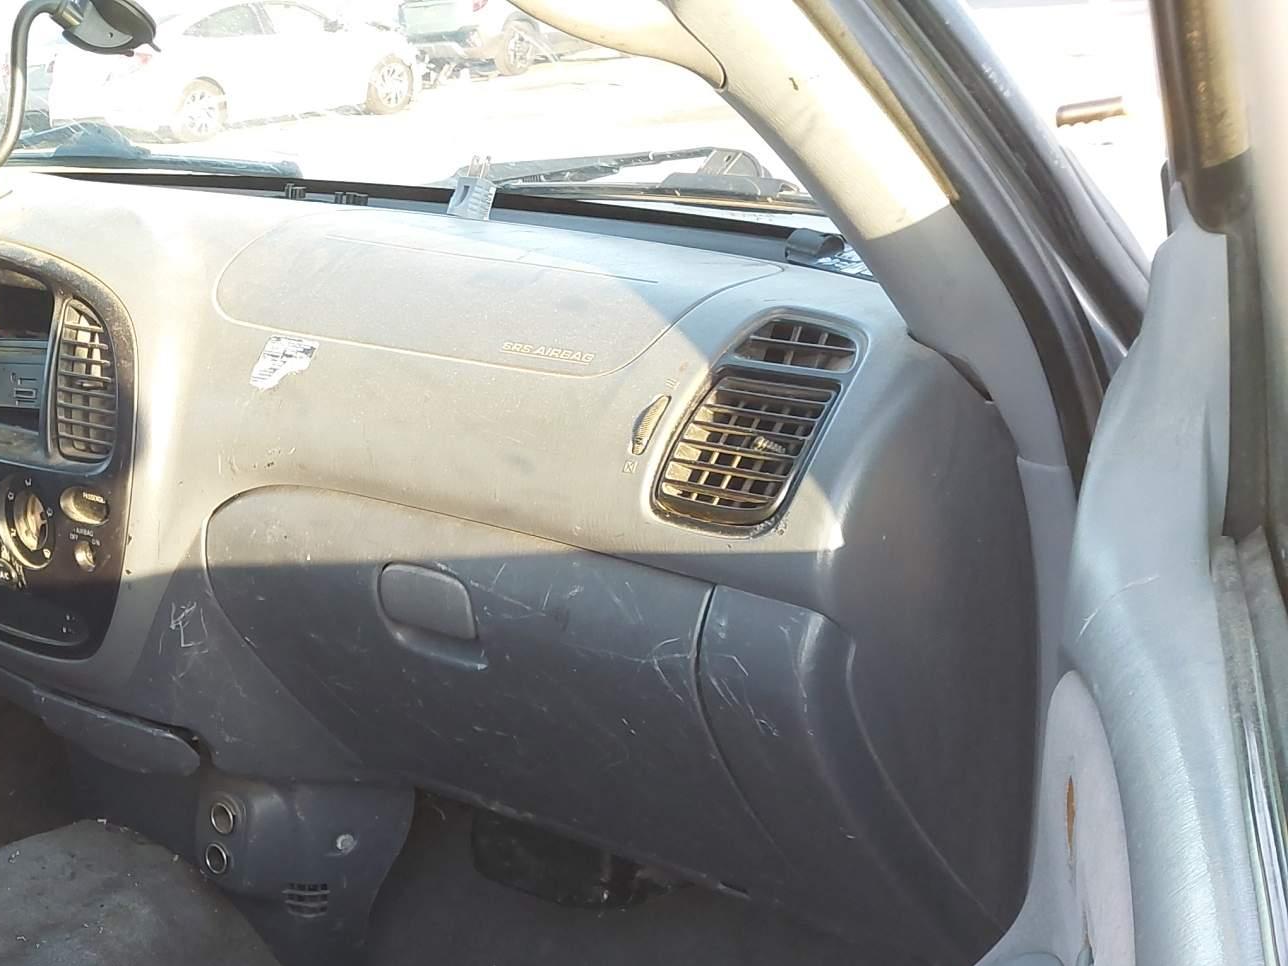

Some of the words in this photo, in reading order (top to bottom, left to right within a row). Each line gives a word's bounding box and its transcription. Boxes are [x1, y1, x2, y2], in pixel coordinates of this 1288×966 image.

[502, 341, 533, 353] SRS
[534, 345, 595, 362] AIRBAG
[69, 533, 79, 541] OFF
[76, 527, 94, 537] AIRBAG
